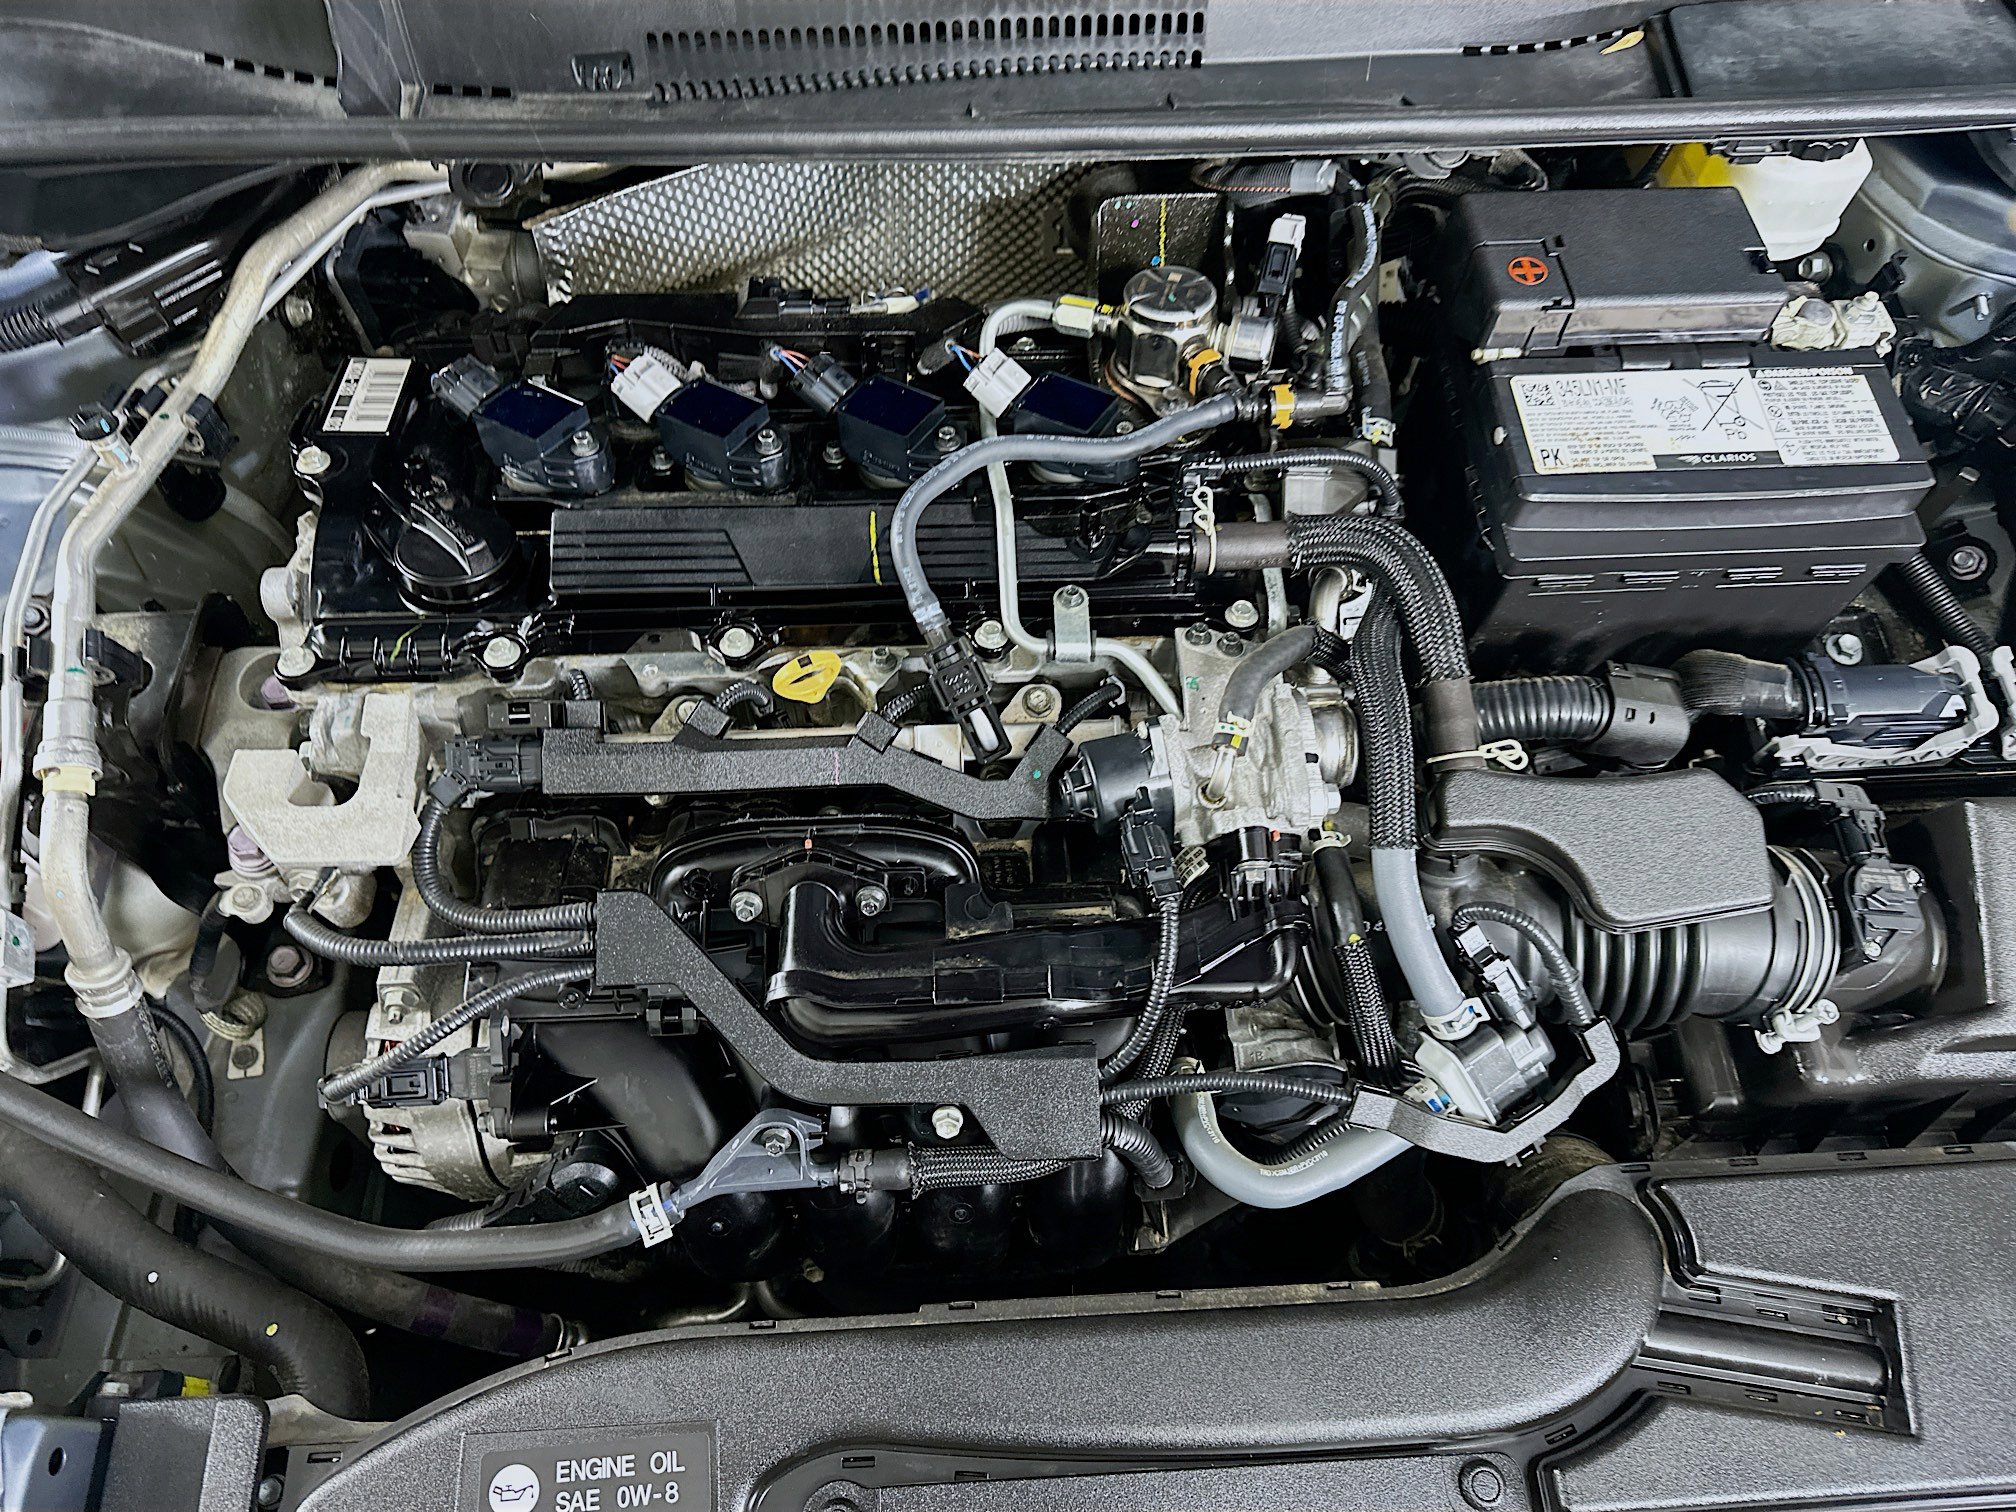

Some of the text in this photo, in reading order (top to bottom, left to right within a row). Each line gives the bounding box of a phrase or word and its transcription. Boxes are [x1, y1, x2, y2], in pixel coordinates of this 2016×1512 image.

[1540, 448, 1565, 467] PK
[1701, 452, 1757, 464] CLARIOS
[555, 1450, 686, 1484] ENGINE OIL
[555, 1481, 680, 1512] SAE 0W-8
